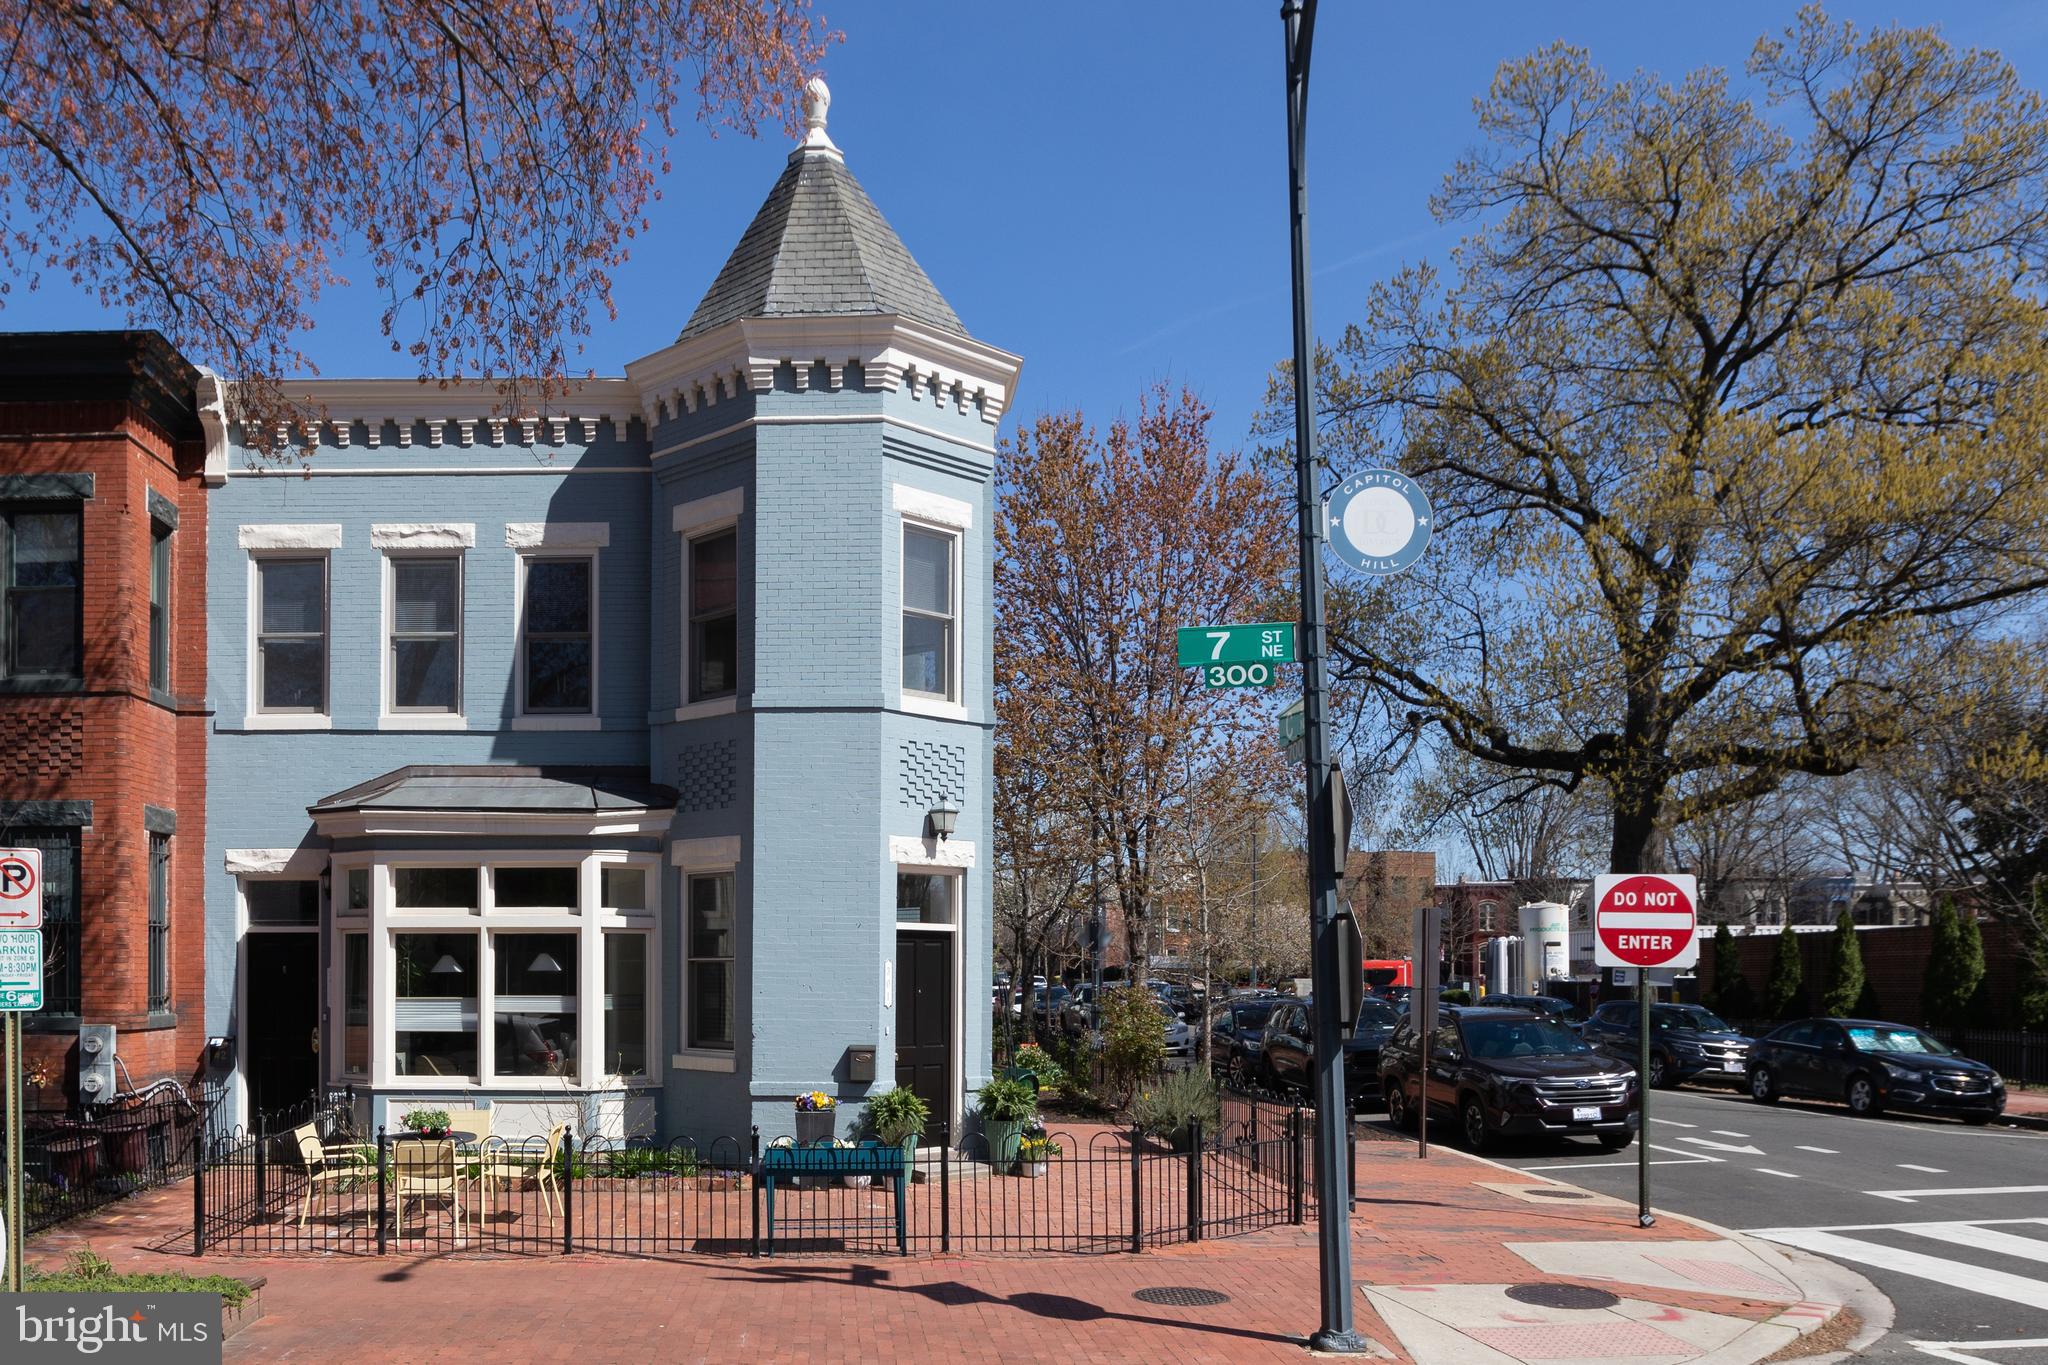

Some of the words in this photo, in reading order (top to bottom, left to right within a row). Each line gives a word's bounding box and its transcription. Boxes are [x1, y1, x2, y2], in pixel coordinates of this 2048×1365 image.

[1343, 474, 1409, 495] CAPITOL
[1361, 558, 1400, 570] HILL
[1206, 631, 1231, 660] 7
[1261, 630, 1284, 643] ST
[1261, 644, 1284, 658] NE
[1209, 663, 1269, 687] 300
[1614, 891, 1637, 906] DO
[1644, 892, 1678, 907] NOT
[12, 934, 36, 944] HOUR
[1618, 934, 1673, 950] ENTER
[6, 991, 17, 1001] 6
